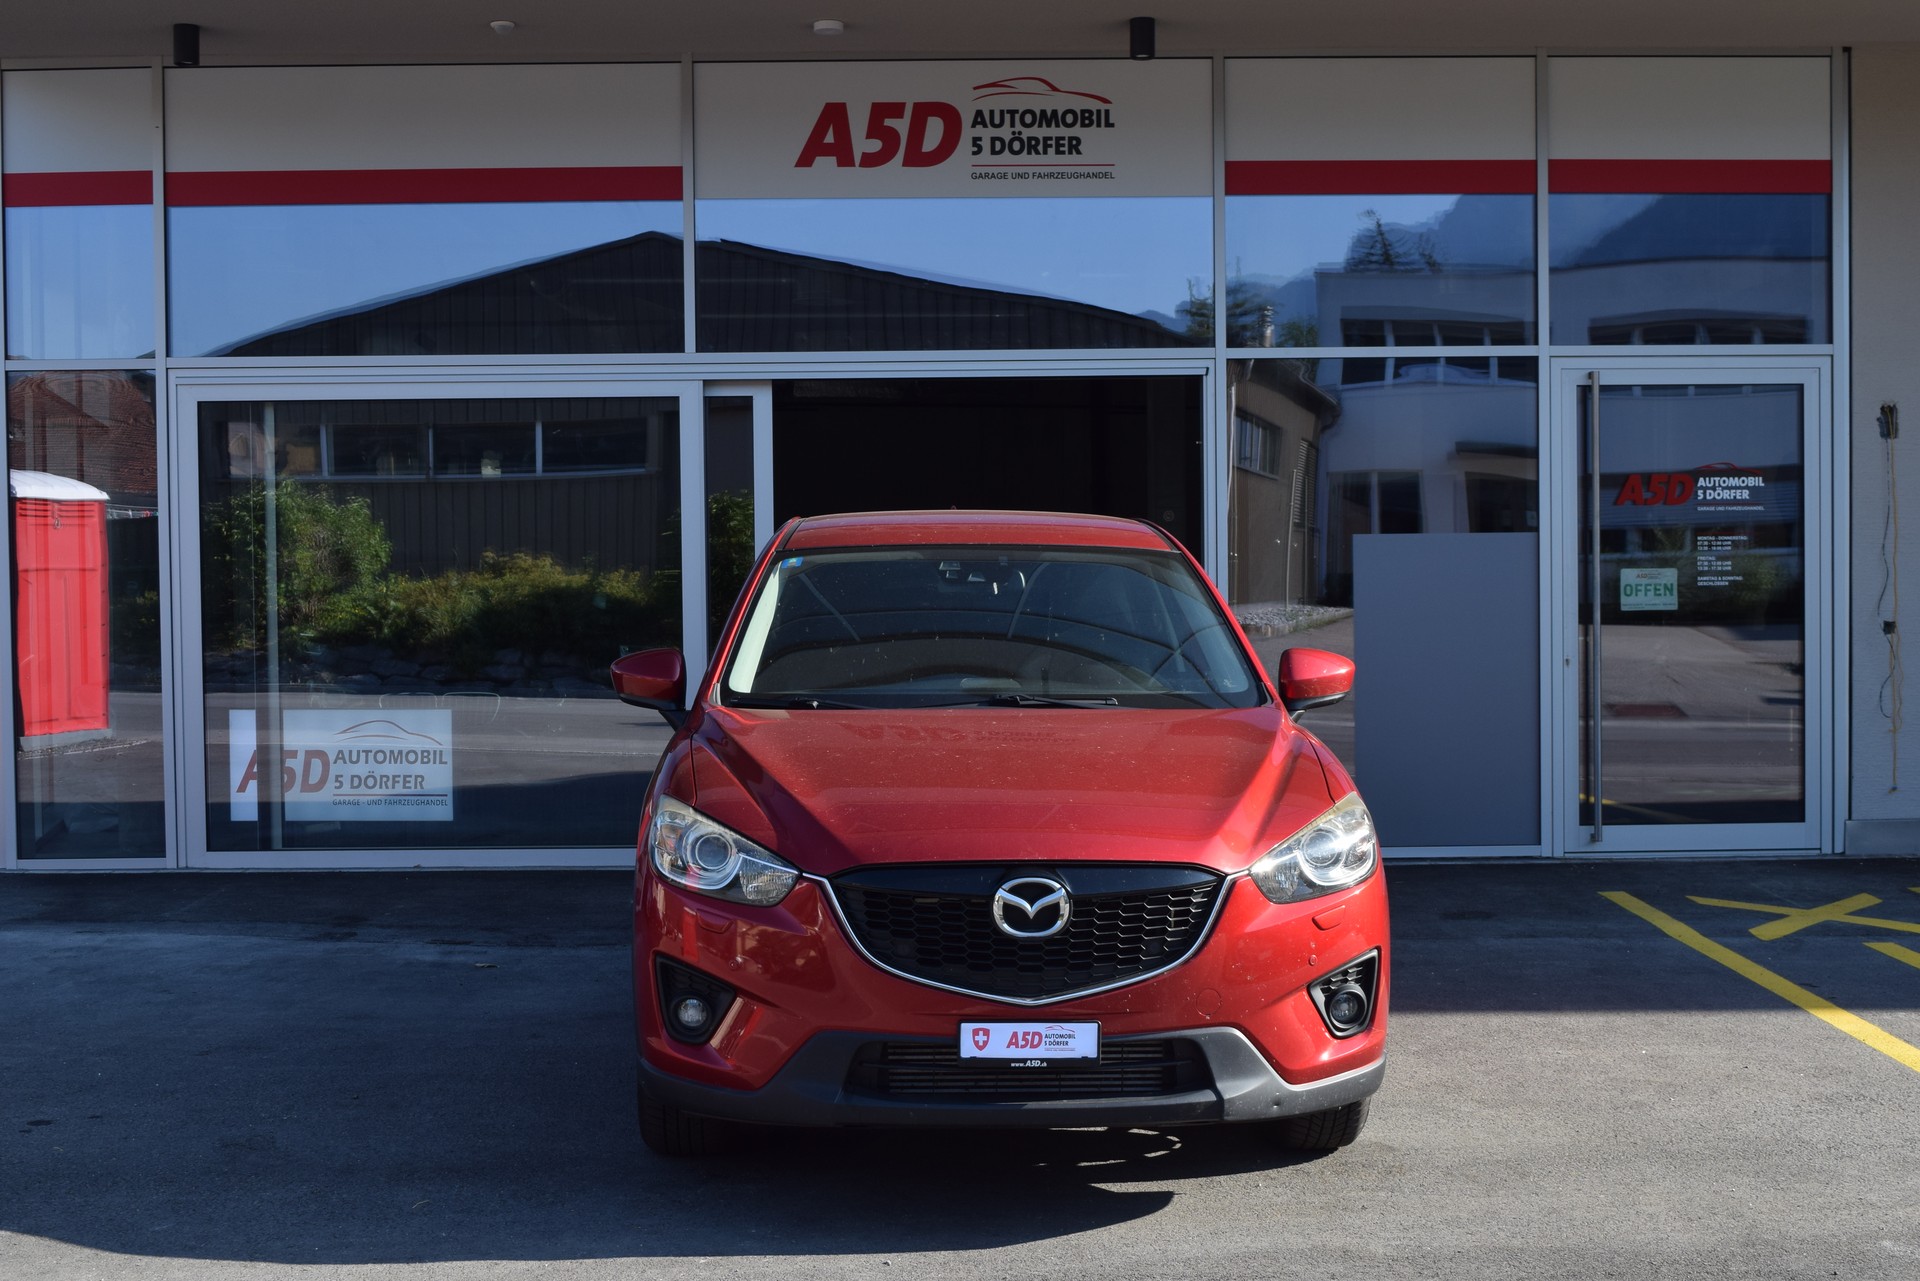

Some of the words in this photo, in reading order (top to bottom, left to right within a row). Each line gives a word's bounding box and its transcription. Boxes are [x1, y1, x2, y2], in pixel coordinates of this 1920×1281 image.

[971, 109, 1115, 129] AUTOMOBIL
[794, 101, 963, 168] A5D
[971, 136, 983, 156] 5
[990, 130, 1083, 156] DÖRFER
[971, 172, 1009, 181] GARAGE
[1011, 171, 1030, 180] UND
[1032, 170, 1116, 180] FAHRZEUGHANDEL
[1615, 473, 1695, 506] A5D
[1697, 476, 1765, 487] AUTOMOBIL
[1697, 489, 1704, 500] 5
[1706, 487, 1750, 500] DÖRFER
[1623, 583, 1674, 597] OFFEN
[333, 749, 448, 765] AUTOMOBIL
[334, 774, 344, 790] 5
[350, 770, 425, 790] DÖRFER
[332, 798, 361, 806] GARAGE
[384, 798, 448, 806] FAHRZEUGHANDEL
[1006, 1031, 1043, 1049] A5D
